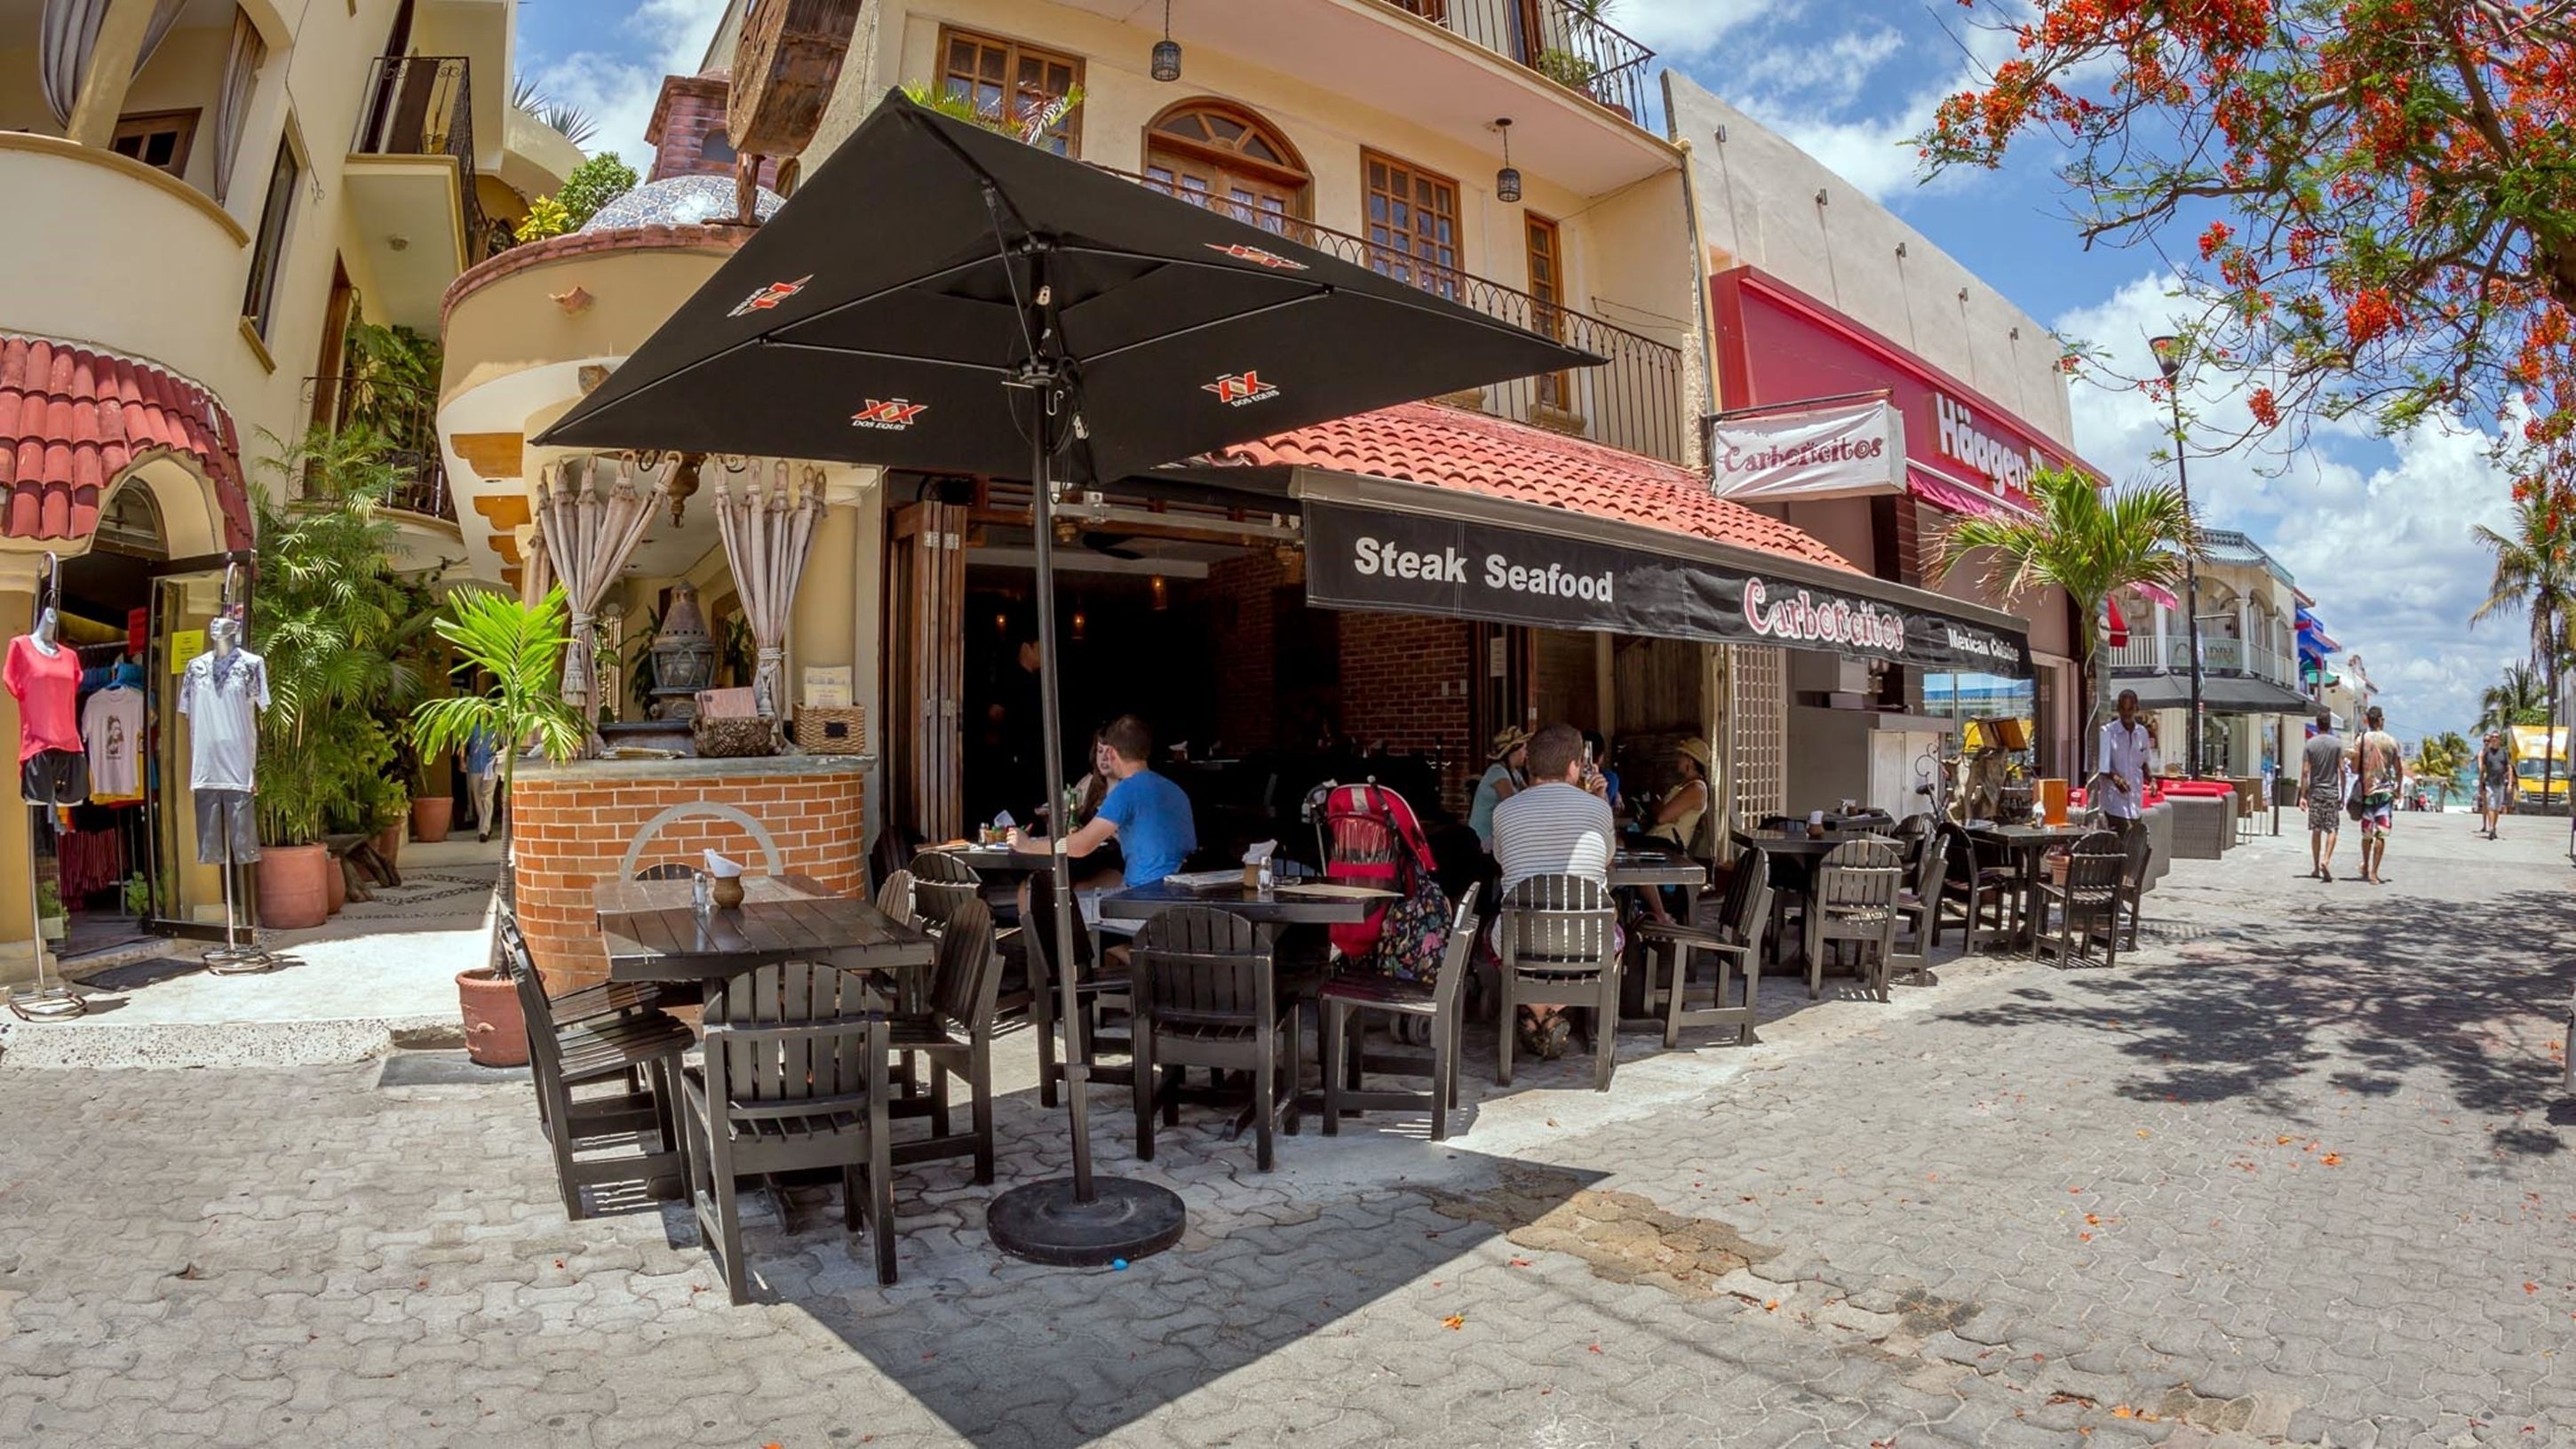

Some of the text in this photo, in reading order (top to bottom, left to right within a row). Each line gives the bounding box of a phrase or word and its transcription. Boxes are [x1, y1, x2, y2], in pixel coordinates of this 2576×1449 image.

[852, 419, 906, 431] DOS EQUIS
[1354, 537, 1614, 603] Steak Seafood
[1947, 627, 2019, 662] Mexican Cuisine
